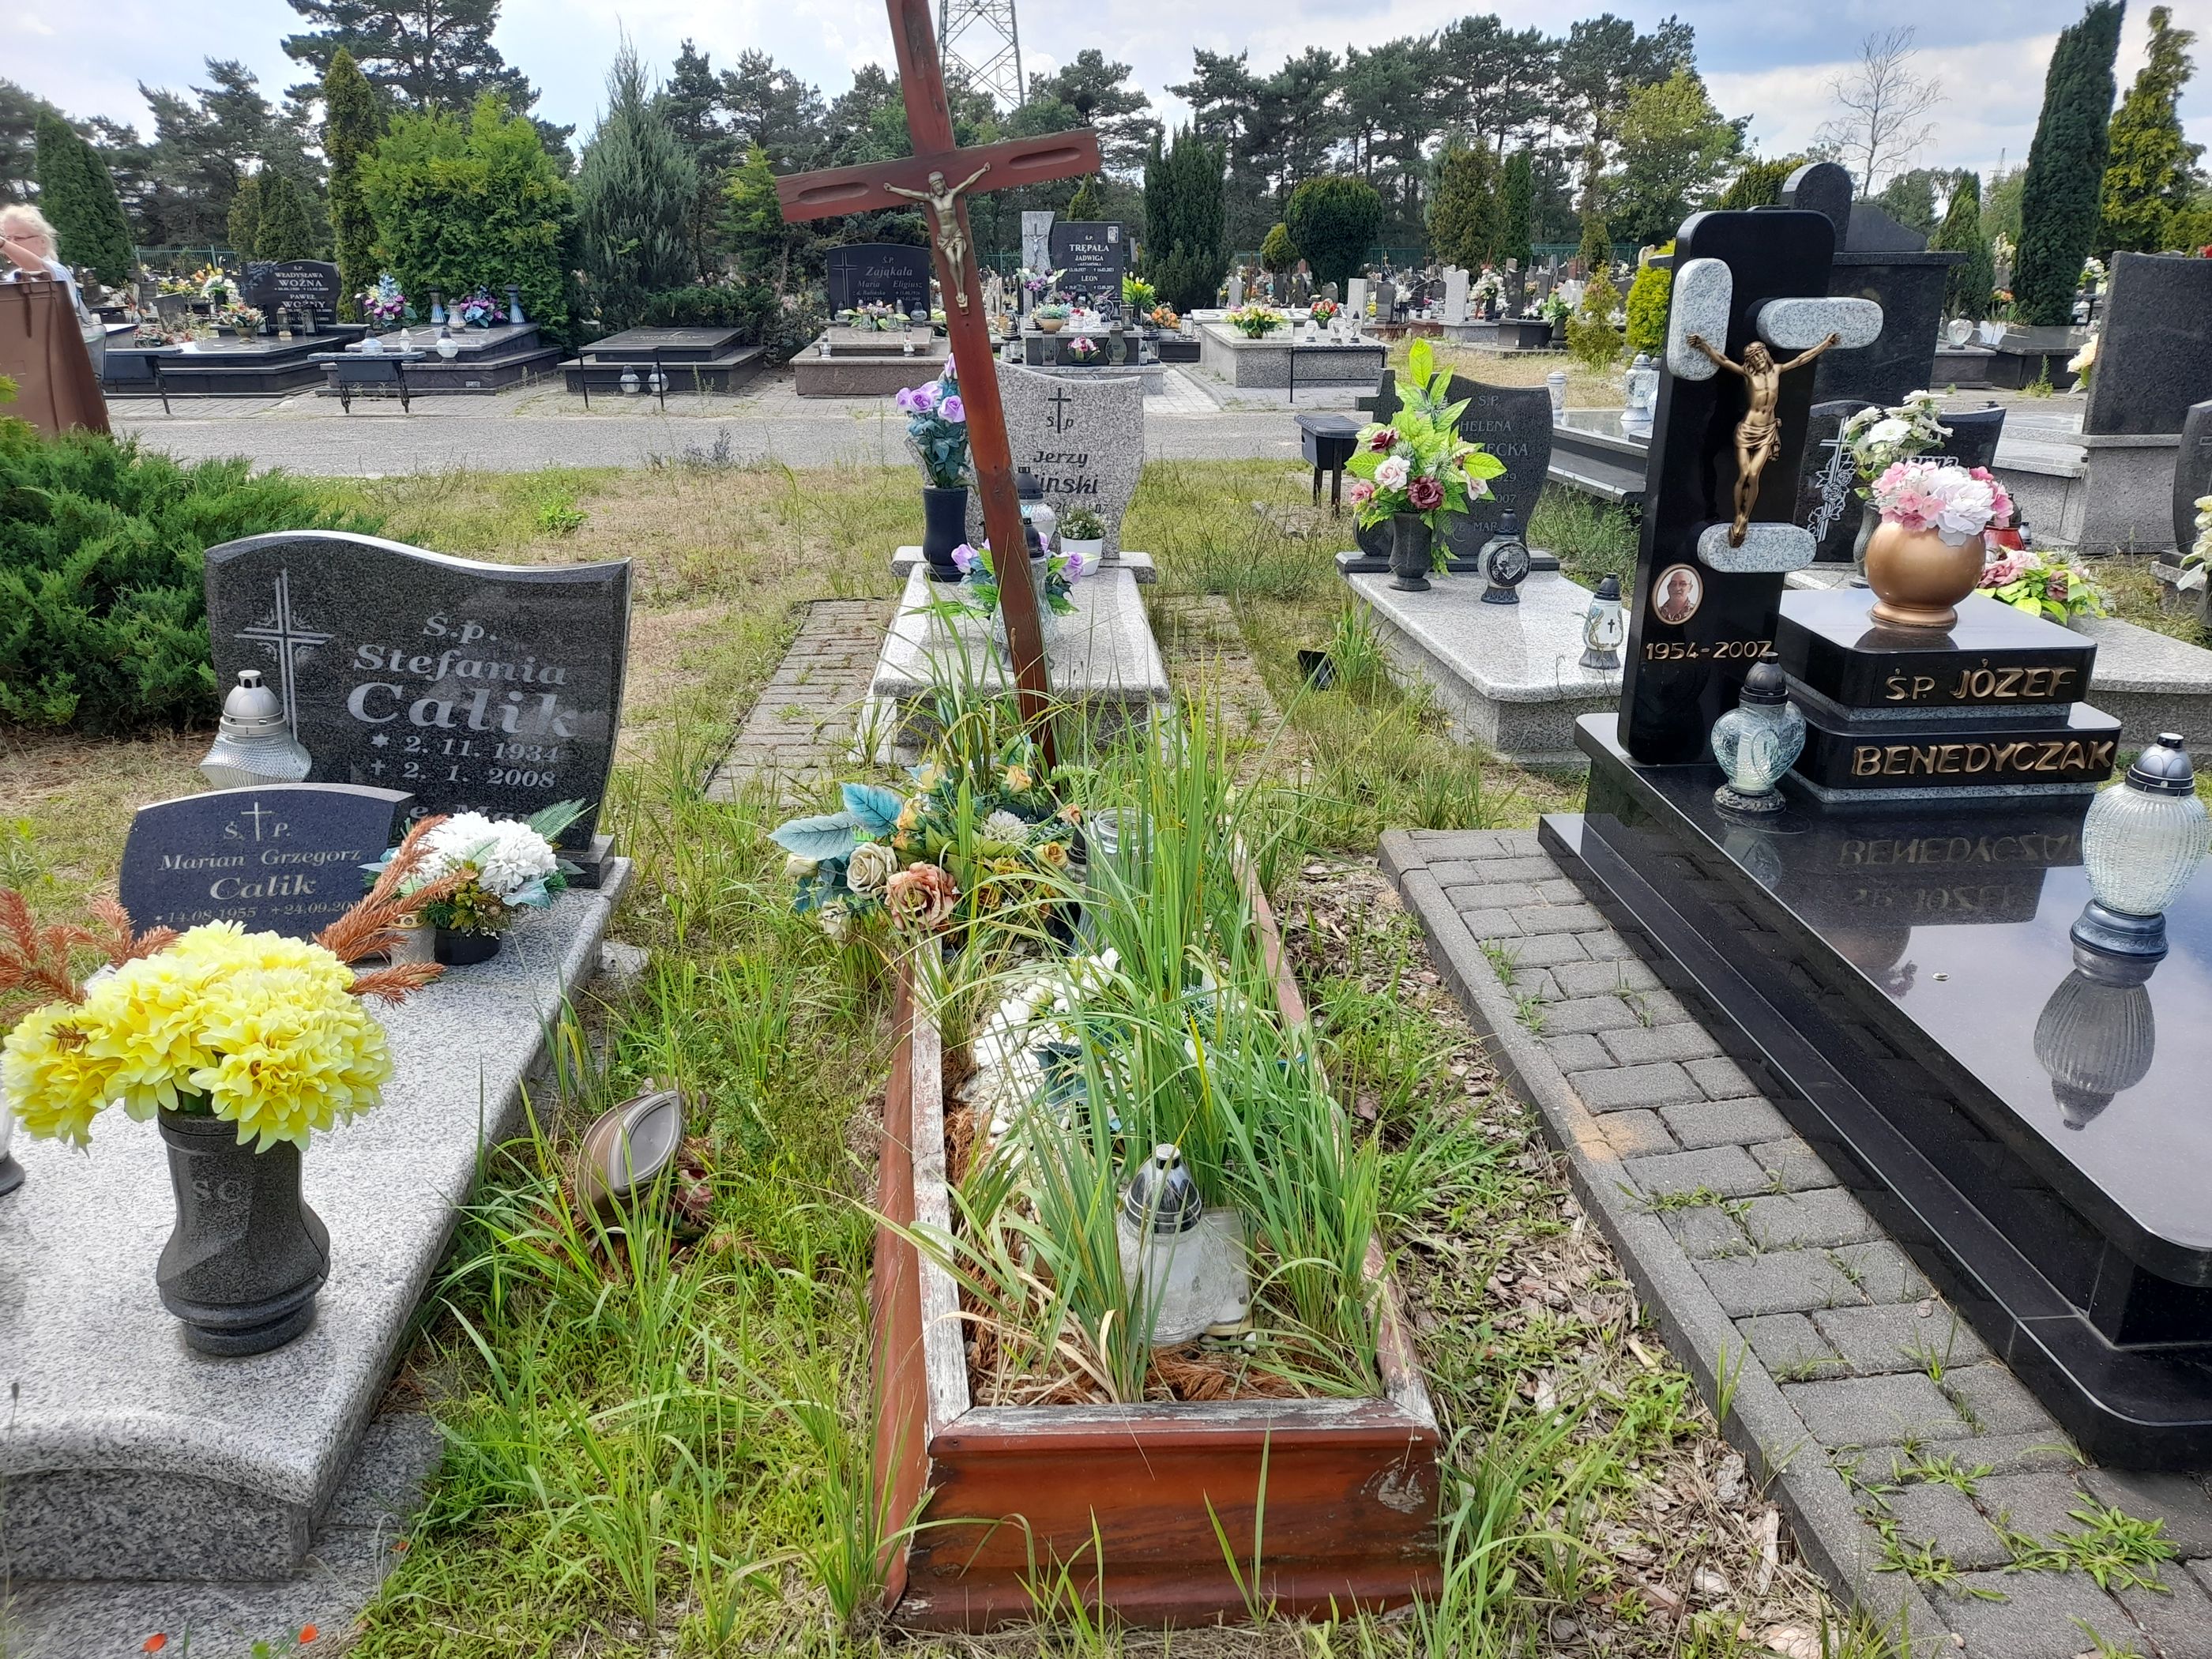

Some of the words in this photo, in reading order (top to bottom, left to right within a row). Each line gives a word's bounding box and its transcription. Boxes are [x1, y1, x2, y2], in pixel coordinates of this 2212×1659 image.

[1068, 244, 1110, 254] TRĘPAŁA
[278, 278, 323, 287] WOŹNA
[893, 280, 923, 290] Eligiusz
[1460, 420, 1512, 432] HELENA
[1033, 450, 1089, 468] Jerzy
[1034, 472, 1099, 495] iński
[423, 611, 498, 644] Ś.p.
[1646, 640, 1773, 660] 1954-2007
[352, 643, 567, 686] Stefania
[1949, 657, 2078, 699] JÓZEF
[347, 681, 580, 739] Calik
[491, 743, 559, 763] 1934
[1853, 739, 2115, 777] BENEDYCZAK
[486, 767, 556, 788] 2008
[160, 853, 245, 871] Marian
[261, 848, 363, 868] Grzegorz
[209, 874, 318, 901] Calik
[167, 907, 258, 924] 14.08.1955
[284, 901, 352, 916] 24.09.20
